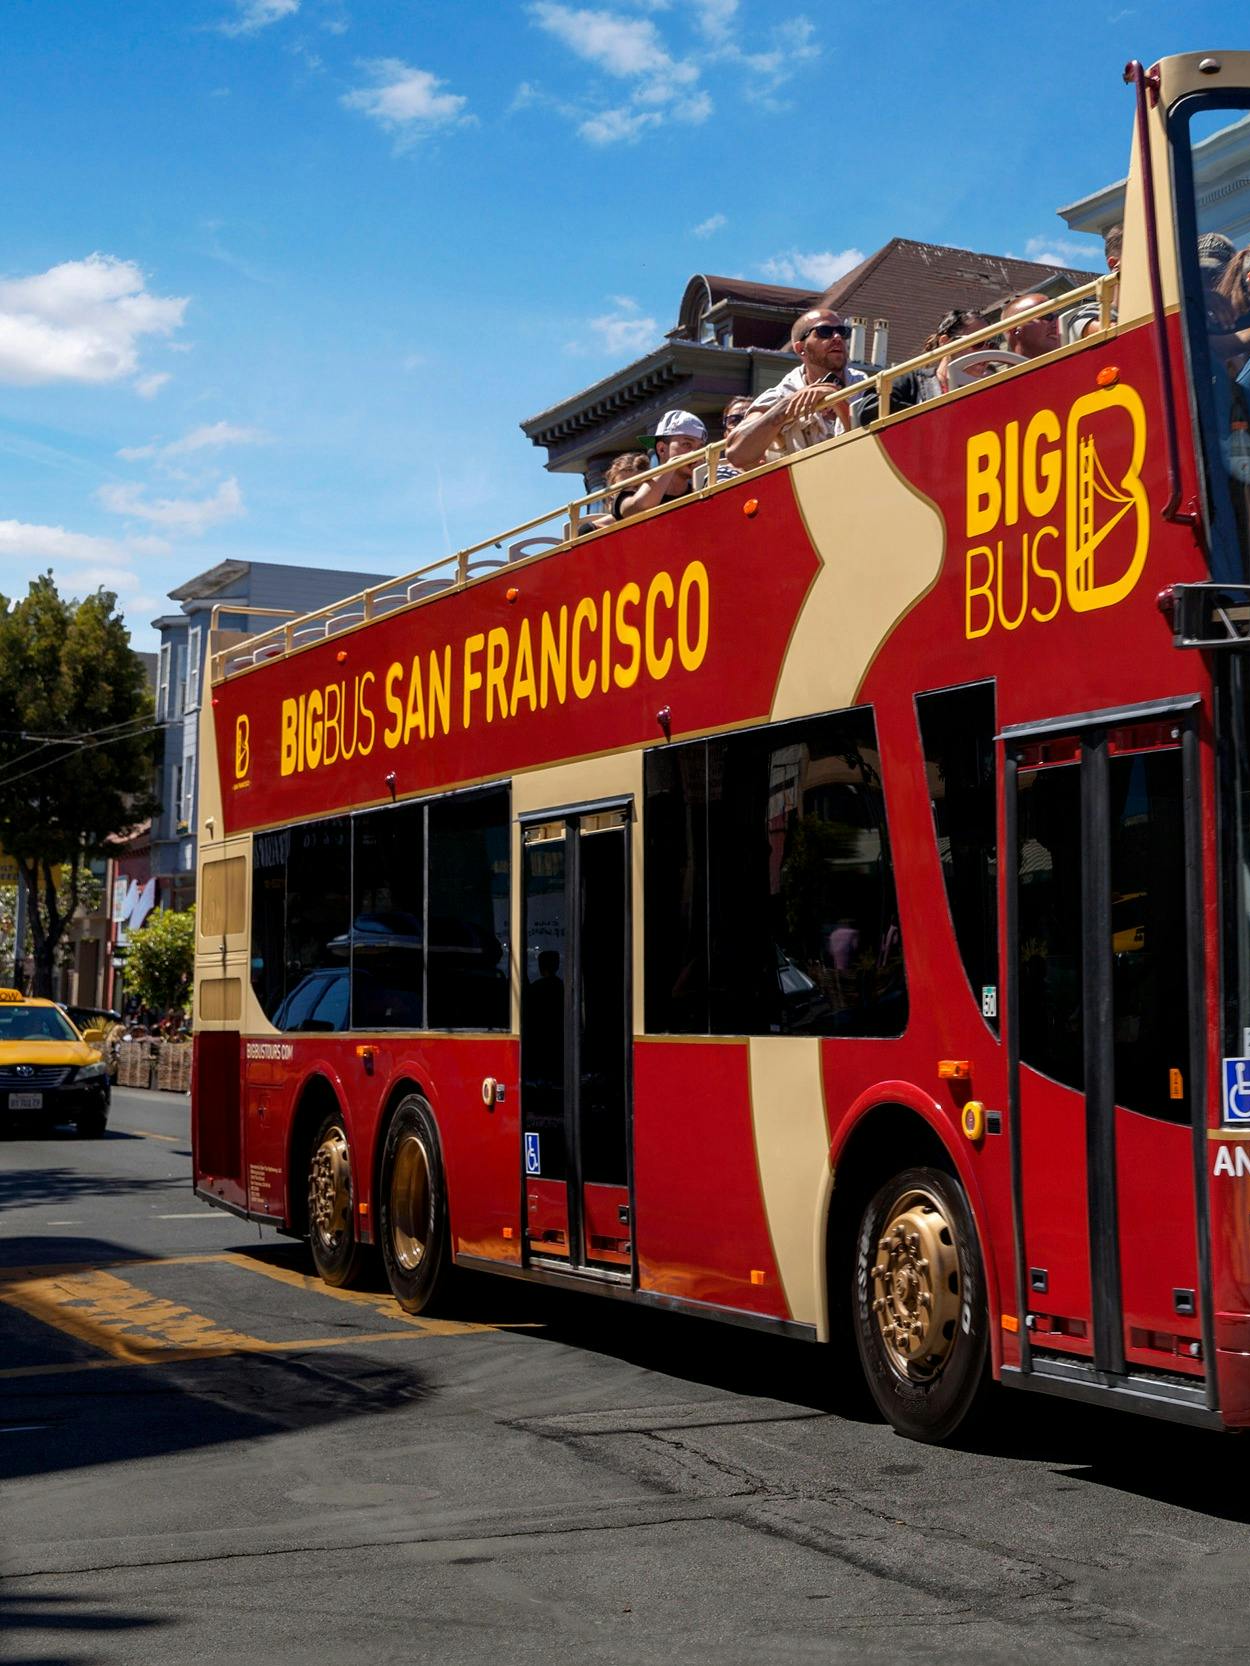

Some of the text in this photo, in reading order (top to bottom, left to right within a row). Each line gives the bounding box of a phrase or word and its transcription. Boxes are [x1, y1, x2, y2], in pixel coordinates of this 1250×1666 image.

[967, 409, 1061, 538] BIG
[966, 525, 1062, 640] BUS
[281, 560, 710, 777] BIGBUS SAN FRANCISCO
[246, 1043, 294, 1060] BIGBUSTOURS.COM
